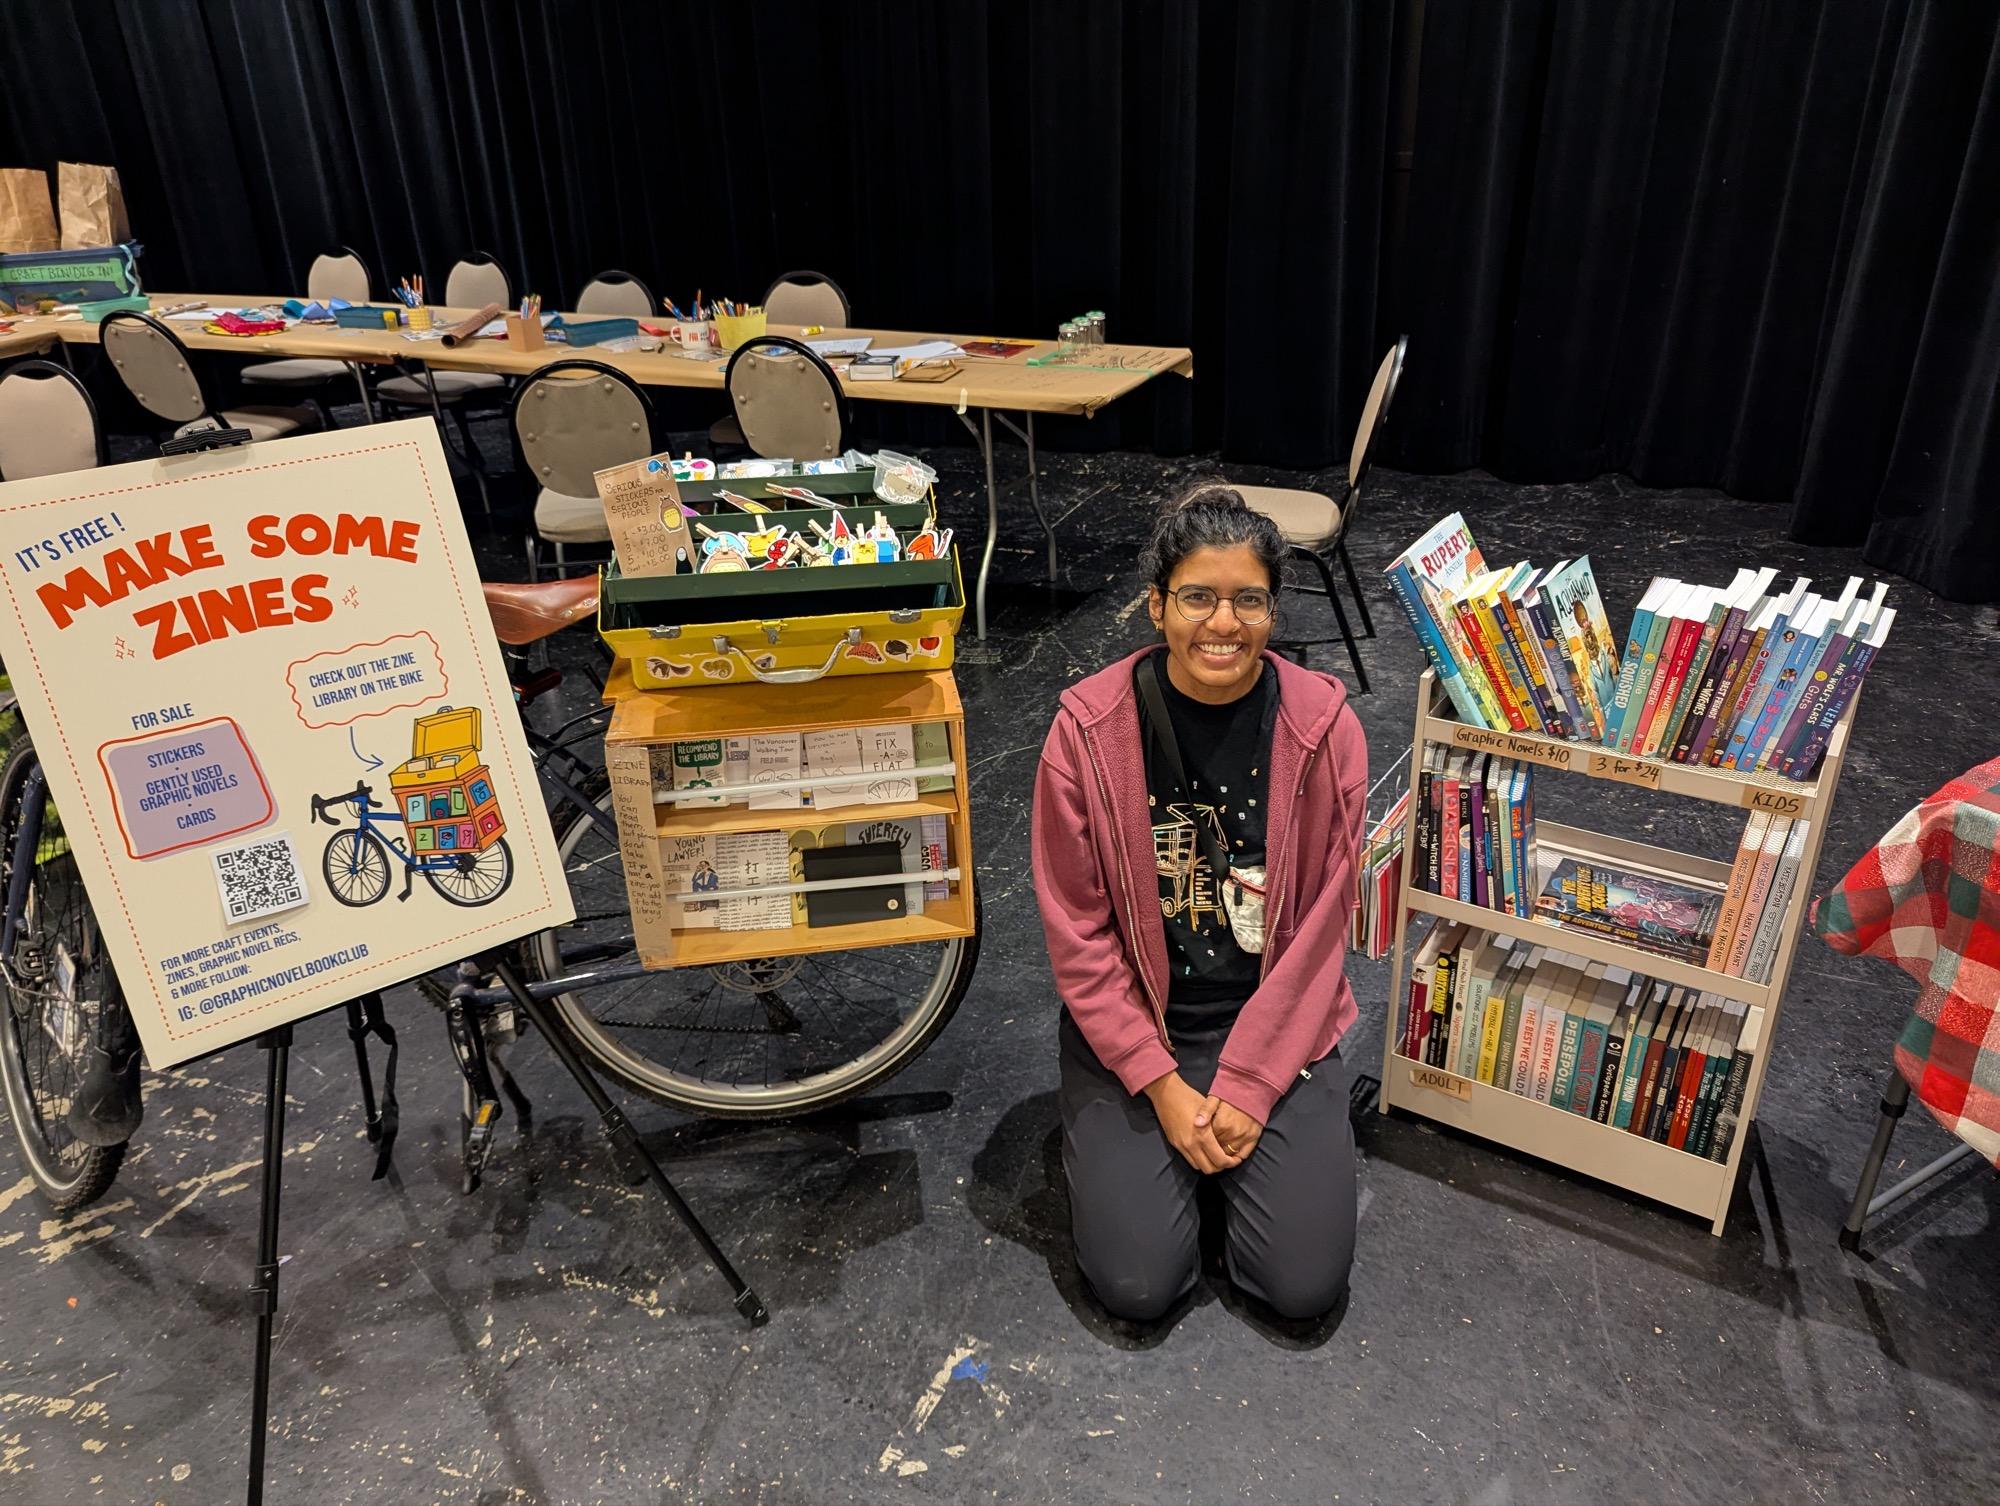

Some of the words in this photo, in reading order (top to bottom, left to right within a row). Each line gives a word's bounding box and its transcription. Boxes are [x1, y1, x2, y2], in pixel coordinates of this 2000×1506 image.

[10, 267, 45, 280] CRAFT
[73, 267, 94, 279] DIG
[605, 478, 643, 494] SERIOUS
[616, 487, 654, 503] STICKERS
[611, 498, 649, 513] SERIOUS
[622, 506, 651, 519] PEOPLE
[15, 538, 61, 572] IT'S
[59, 517, 114, 553] FREE
[1433, 531, 1444, 543] THE
[1420, 528, 1468, 577] RUPERT
[35, 524, 225, 630] MAKE
[247, 513, 420, 563] SOME
[132, 574, 333, 660] ZINES
[1427, 603, 1446, 630] RUPERT
[1550, 624, 1573, 663] AQUANAUT
[1693, 641, 1708, 661] Anne
[309, 669, 345, 688] CHECK
[346, 663, 367, 679] OUT
[368, 658, 390, 674] THE
[391, 652, 416, 668] ZINE
[1507, 630, 1515, 643] THE
[1526, 676, 1537, 691] CLUB
[1523, 650, 1540, 677] SPARKS!
[1831, 661, 1846, 677] MR.
[313, 687, 358, 708] LIBRARY
[361, 681, 377, 696] ON
[378, 675, 399, 692] THE
[399, 670, 424, 686] BIKE
[1633, 667, 1651, 695] Smile
[1645, 667, 1665, 705] allergic
[1665, 675, 1678, 695] SUNNY
[1682, 667, 1698, 687] Green
[1703, 677, 1714, 688] THE
[1716, 679, 1730, 696] BEST
[1818, 676, 1838, 704] WOLF'S
[1502, 684, 1517, 708] DRAGON
[1691, 686, 1713, 716] WITCHES
[1707, 695, 1723, 720] FRIENDS
[1797, 683, 1820, 712] Guts
[131, 712, 159, 730] FOR
[160, 703, 194, 723] SALE
[1806, 701, 1824, 726] CLASS
[1817, 706, 1838, 731] LEAK
[147, 742, 205, 768] STICKERS
[677, 743, 718, 755] RECOMMEND
[694, 752, 719, 761] LIBRARY
[876, 739, 897, 750] FIX
[1457, 728, 1503, 748] Graphic
[1508, 738, 1544, 757] Novels
[1548, 746, 1570, 764] $10
[612, 760, 647, 770] ZINE
[1596, 757, 1607, 771] 3
[1613, 759, 1631, 774] for
[1634, 762, 1660, 783] $24
[146, 773, 189, 795] GENTLY
[191, 764, 223, 783] USED
[613, 775, 650, 786] LIBRARY
[139, 787, 192, 812] GRAPHIC
[194, 774, 238, 797] NOVELS
[1752, 791, 1799, 813] KIDS
[177, 808, 216, 829] CARDS
[675, 835, 705, 851] YOUNG
[858, 822, 911, 848] SUPERFLY
[1491, 820, 1499, 848] AMULET
[667, 844, 705, 863] LAWYER!
[1429, 842, 1437, 865] WITCH
[1429, 865, 1437, 881] BOY
[1780, 865, 1791, 882] KATE
[1591, 881, 1606, 909] ZONE
[1771, 881, 1786, 907] BEATON
[1557, 913, 1571, 922] THE
[1570, 916, 1612, 932] ADVENTURE
[1614, 927, 1638, 939] ZONE
[1761, 910, 1776, 938] STEP
[160, 956, 181, 972] FOR
[182, 946, 211, 964] MORE
[212, 935, 243, 953] CRAFT
[243, 923, 284, 943] EVENTS,
[165, 967, 199, 985] ZINES,
[199, 950, 241, 973] GRAPHIC
[241, 943, 273, 959] NOVEL
[274, 931, 301, 947] RECS,
[1711, 934, 1727, 963] VAGRANT
[1731, 938, 1747, 967] VAGRANT
[171, 989, 179, 1000] &
[180, 978, 209, 996] MORE
[210, 964, 253, 985] FOLLOW:
[177, 1006, 198, 1022] IG:
[199, 943, 369, 1015] @GRAPHICNOVELBOOKCLUB
[1431, 967, 1449, 1014] WATCHMEN
[1473, 984, 1483, 1011] SOLUTIONS
[1526, 1008, 1536, 1024] THE
[1546, 1019, 1556, 1036] THE
[1522, 1025, 1534, 1046] BEST
[1542, 1036, 1554, 1057] BEST
[1500, 1040, 1511, 1062] BURMA
[1520, 1046, 1531, 1060] WE
[1554, 1019, 1577, 1095] PERSEPOLIS
[1515, 1060, 1528, 1088] COULD
[1540, 1057, 1551, 1072] WE
[1729, 1054, 1747, 1085] LINCOLN
[1418, 1073, 1465, 1094] ADULT
[1535, 1071, 1548, 1101] COULD
[1600, 1063, 1615, 1098] Cyclopedia
[1621, 1075, 1636, 1103] FEYNMAN
[1596, 1099, 1607, 1121] Exotica
[1692, 1104, 1701, 1122] ALISON
[1702, 1106, 1712, 1128] ALISON
